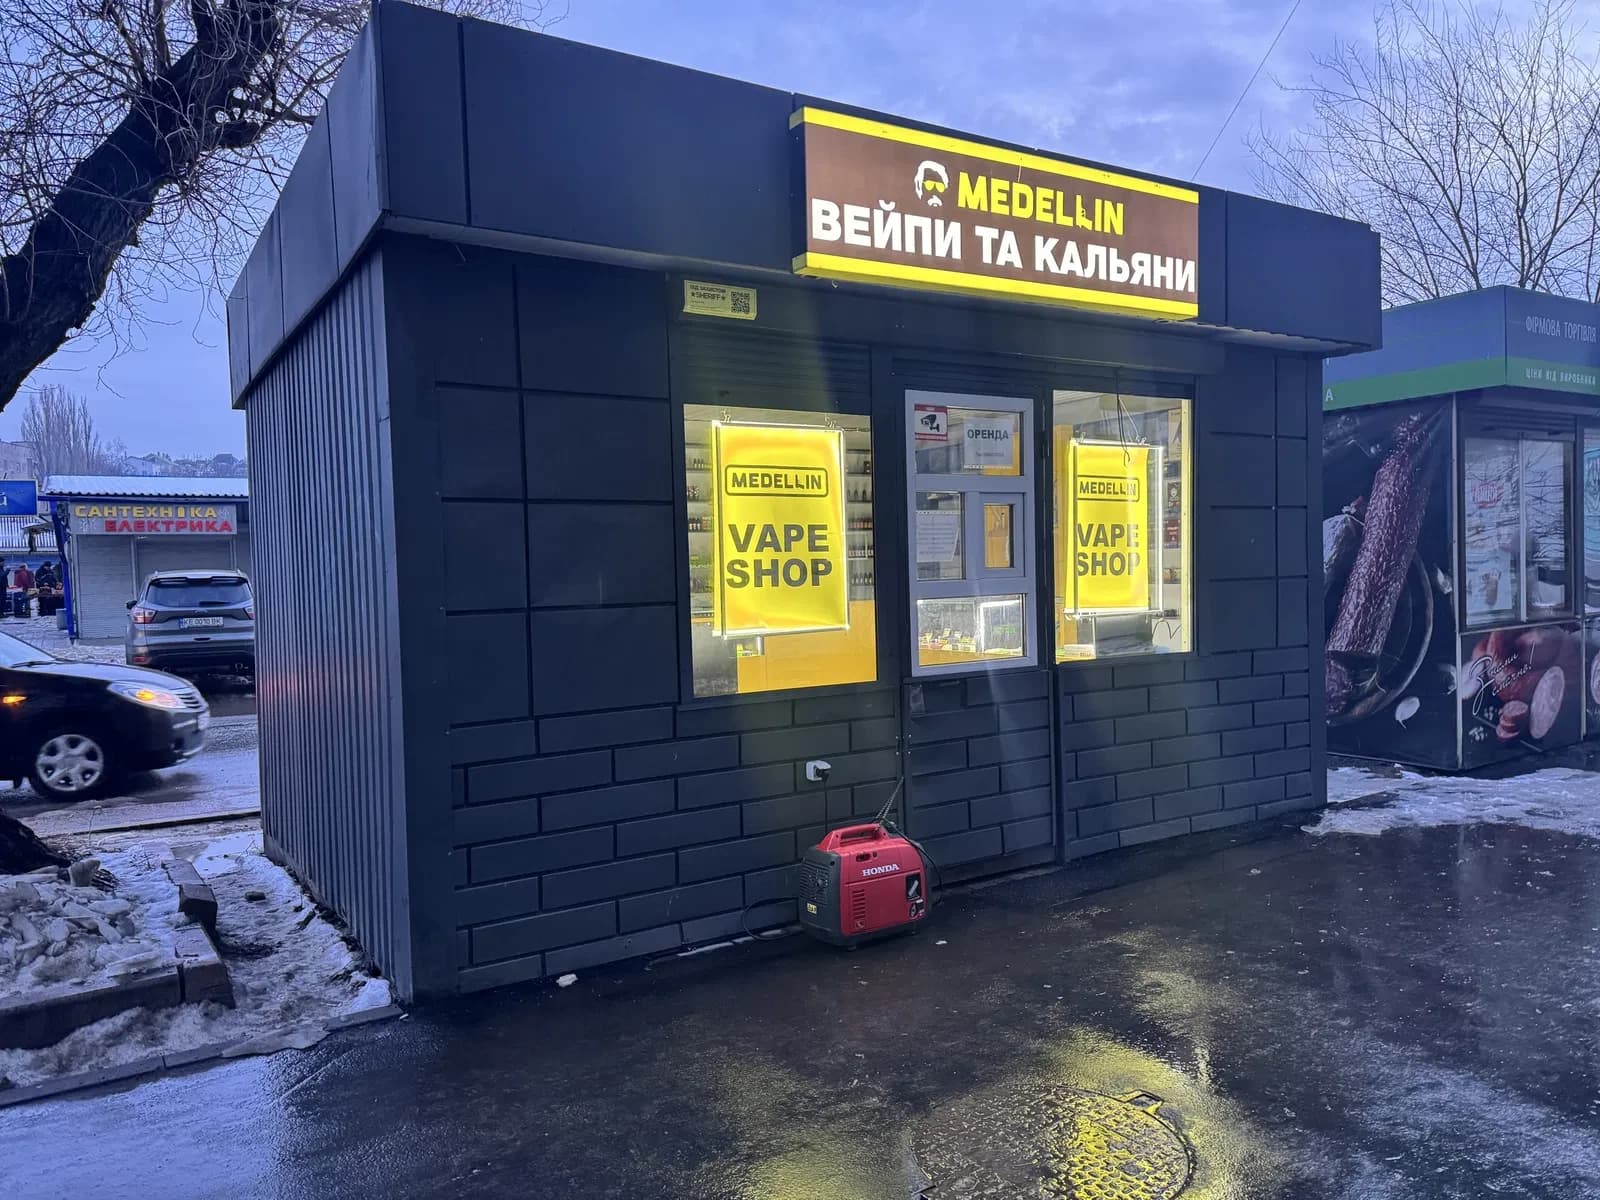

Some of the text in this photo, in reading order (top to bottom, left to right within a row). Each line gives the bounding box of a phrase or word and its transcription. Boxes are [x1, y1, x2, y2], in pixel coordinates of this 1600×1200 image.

[957, 171, 1125, 236] MEDELLIN
[811, 198, 1196, 293] ВЕЙПИ ТА КАЛЬЯНИ
[1525, 315, 1597, 343] ФІРМОВА ТОРГІВЛЯ
[967, 428, 1009, 441] ОРЕНДА
[731, 472, 822, 490] MEDELLIN
[1079, 481, 1137, 496] MEDELLIN
[75, 505, 217, 518] САНТЕХНІКА
[105, 520, 233, 533] ЕЛЕКТРИКА
[728, 523, 830, 553] VAPE
[1077, 523, 1139, 548] VAPE
[726, 558, 833, 589] SHOP
[1077, 551, 1141, 576] SHOP
[862, 863, 900, 877] HONDA
